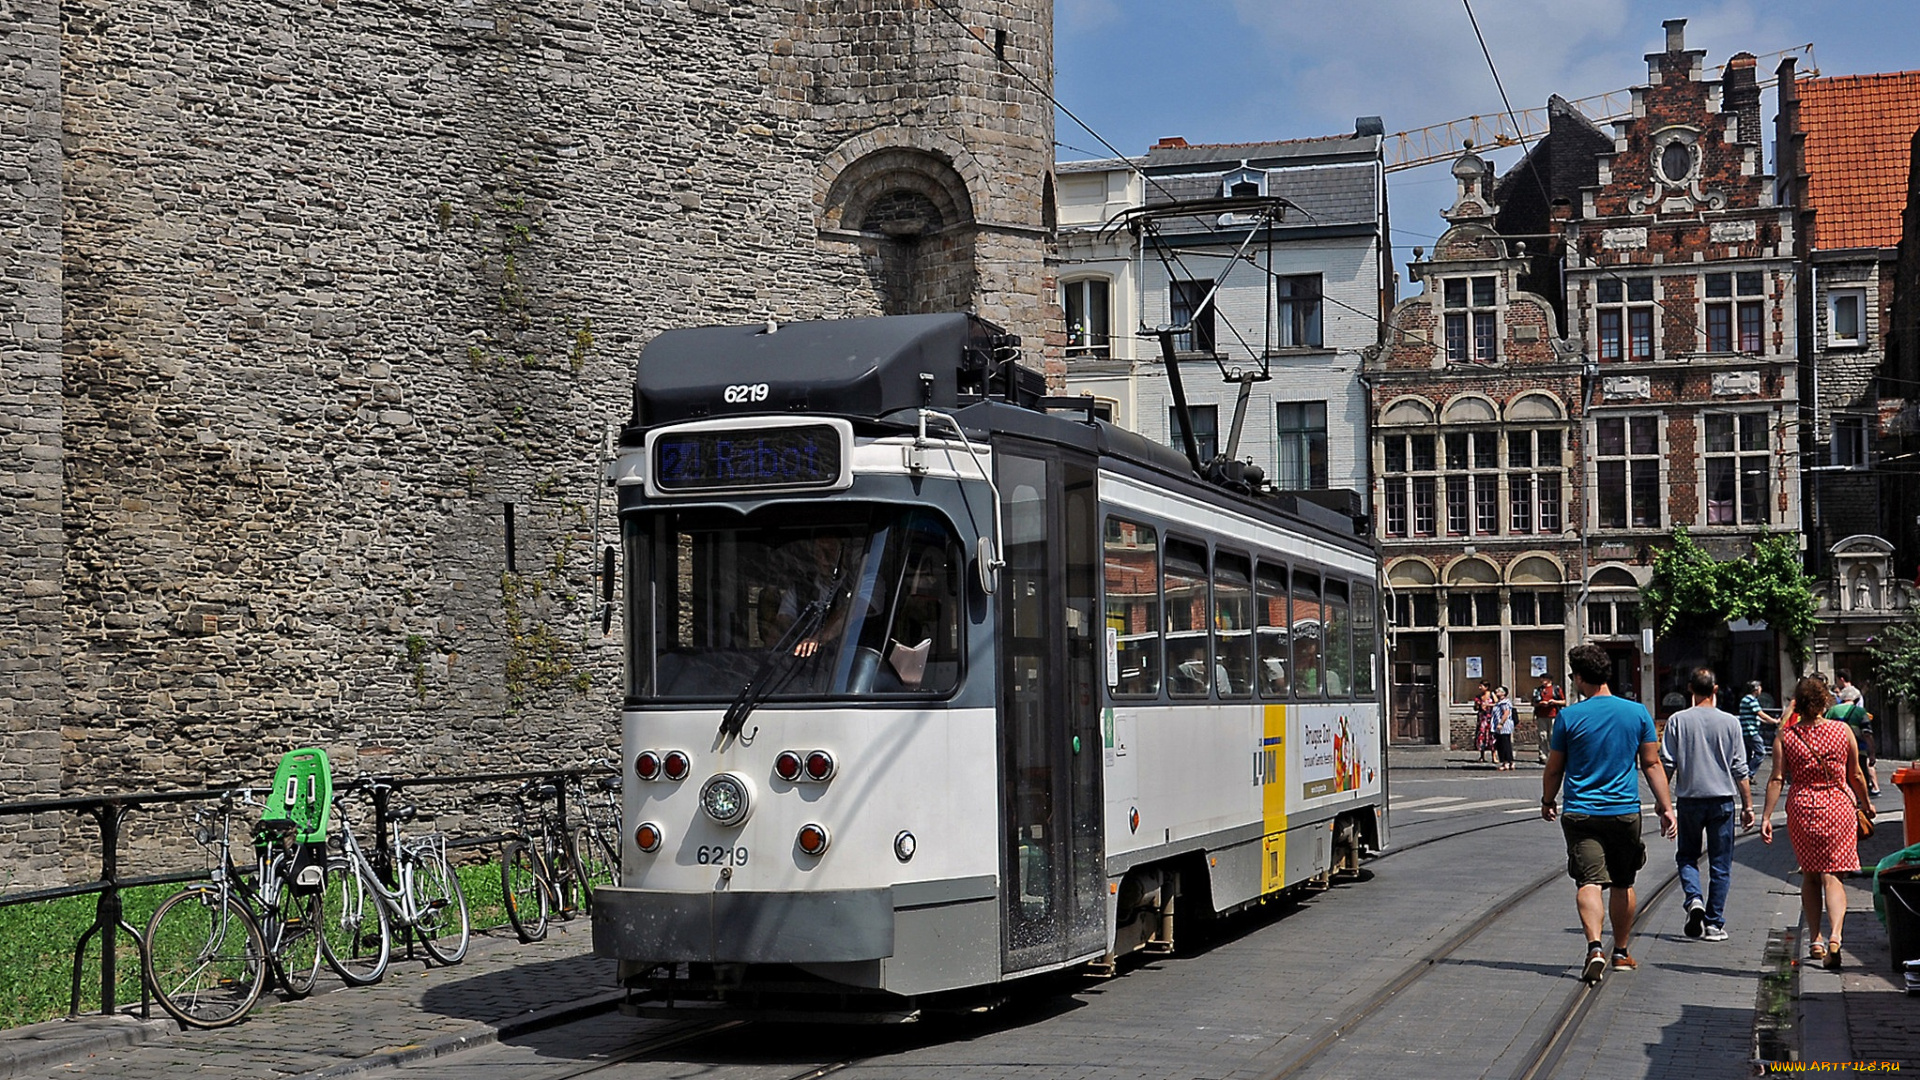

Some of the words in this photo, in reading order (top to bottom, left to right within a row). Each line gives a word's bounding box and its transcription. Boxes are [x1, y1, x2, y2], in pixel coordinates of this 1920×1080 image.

[724, 383, 770, 403] 6219
[717, 437, 819, 479] Rabot
[697, 845, 748, 867] 6219
